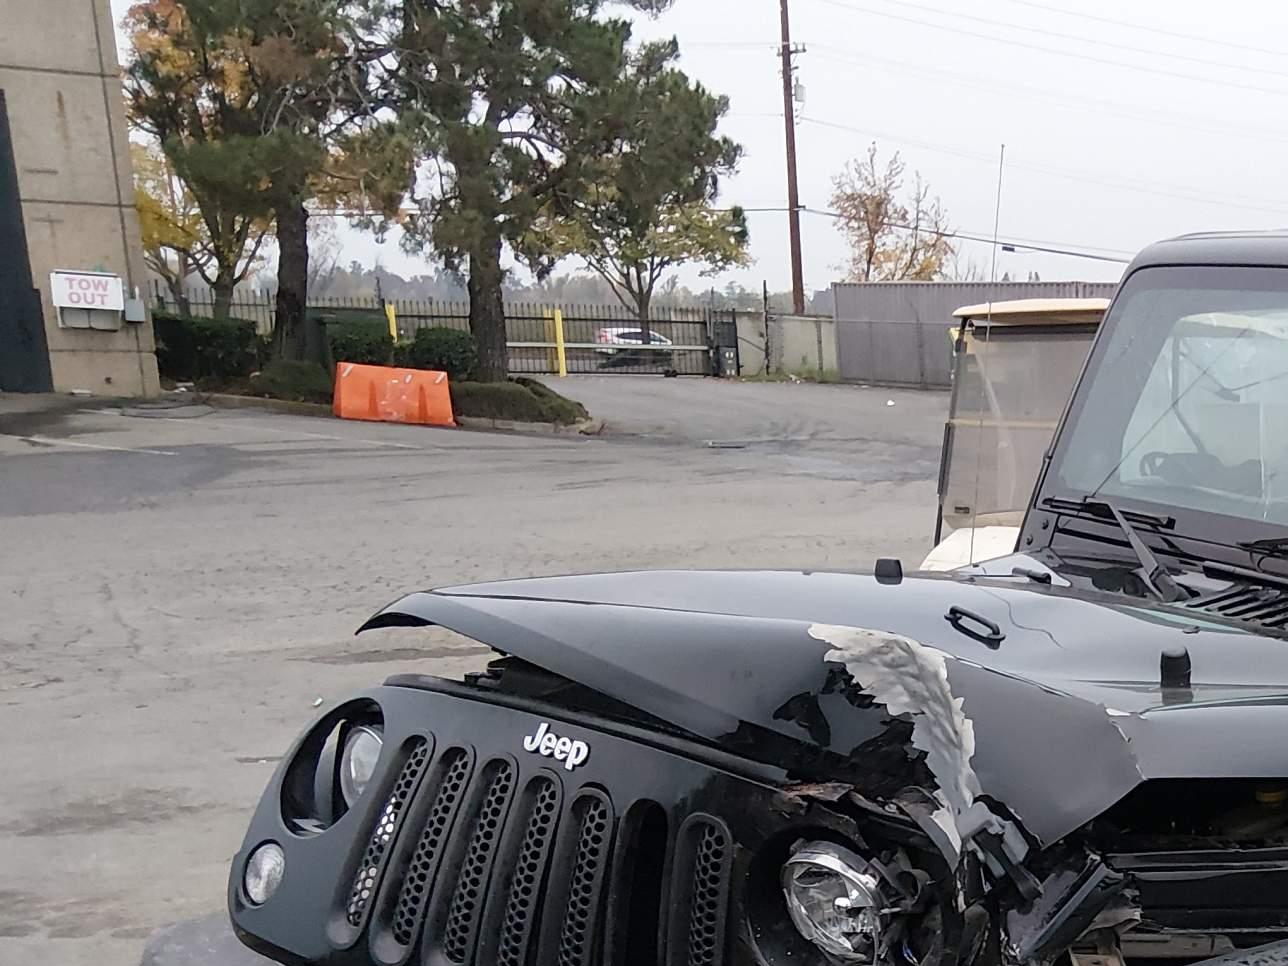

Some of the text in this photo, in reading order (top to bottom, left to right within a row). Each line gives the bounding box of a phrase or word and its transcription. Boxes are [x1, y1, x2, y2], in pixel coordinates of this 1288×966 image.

[64, 277, 109, 292] TOW
[68, 292, 108, 306] OUT
[523, 722, 589, 770] Jeep
